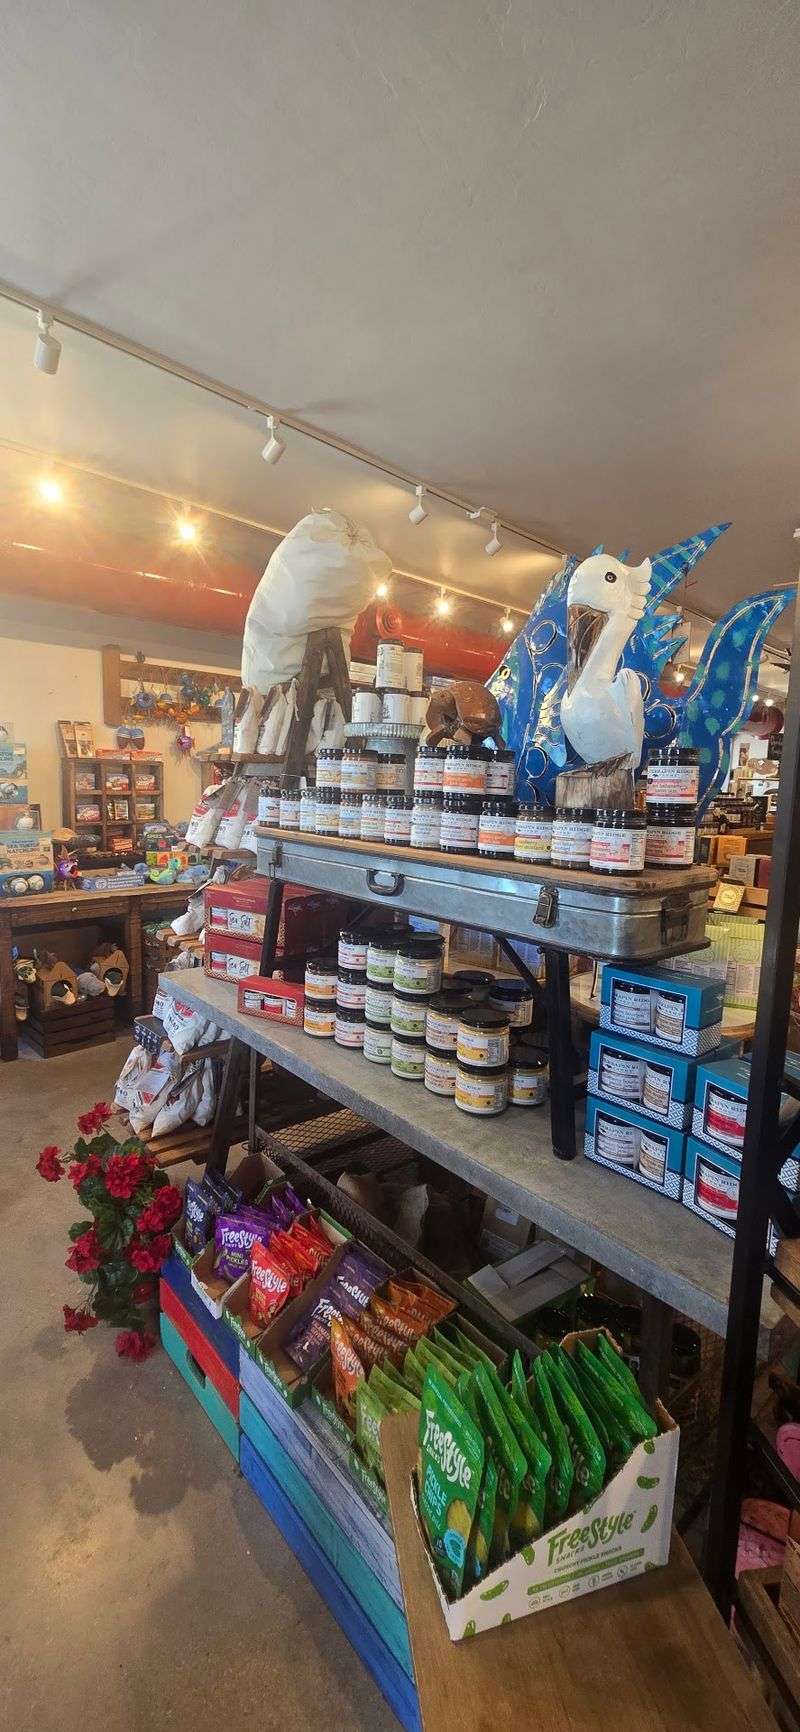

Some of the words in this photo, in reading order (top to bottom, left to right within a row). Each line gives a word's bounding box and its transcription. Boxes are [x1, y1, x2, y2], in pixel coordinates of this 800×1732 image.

[251, 1260, 288, 1293] FreeStyle
[422, 1408, 472, 1490] FreeStyle
[547, 1512, 634, 1566] FreeStyle
